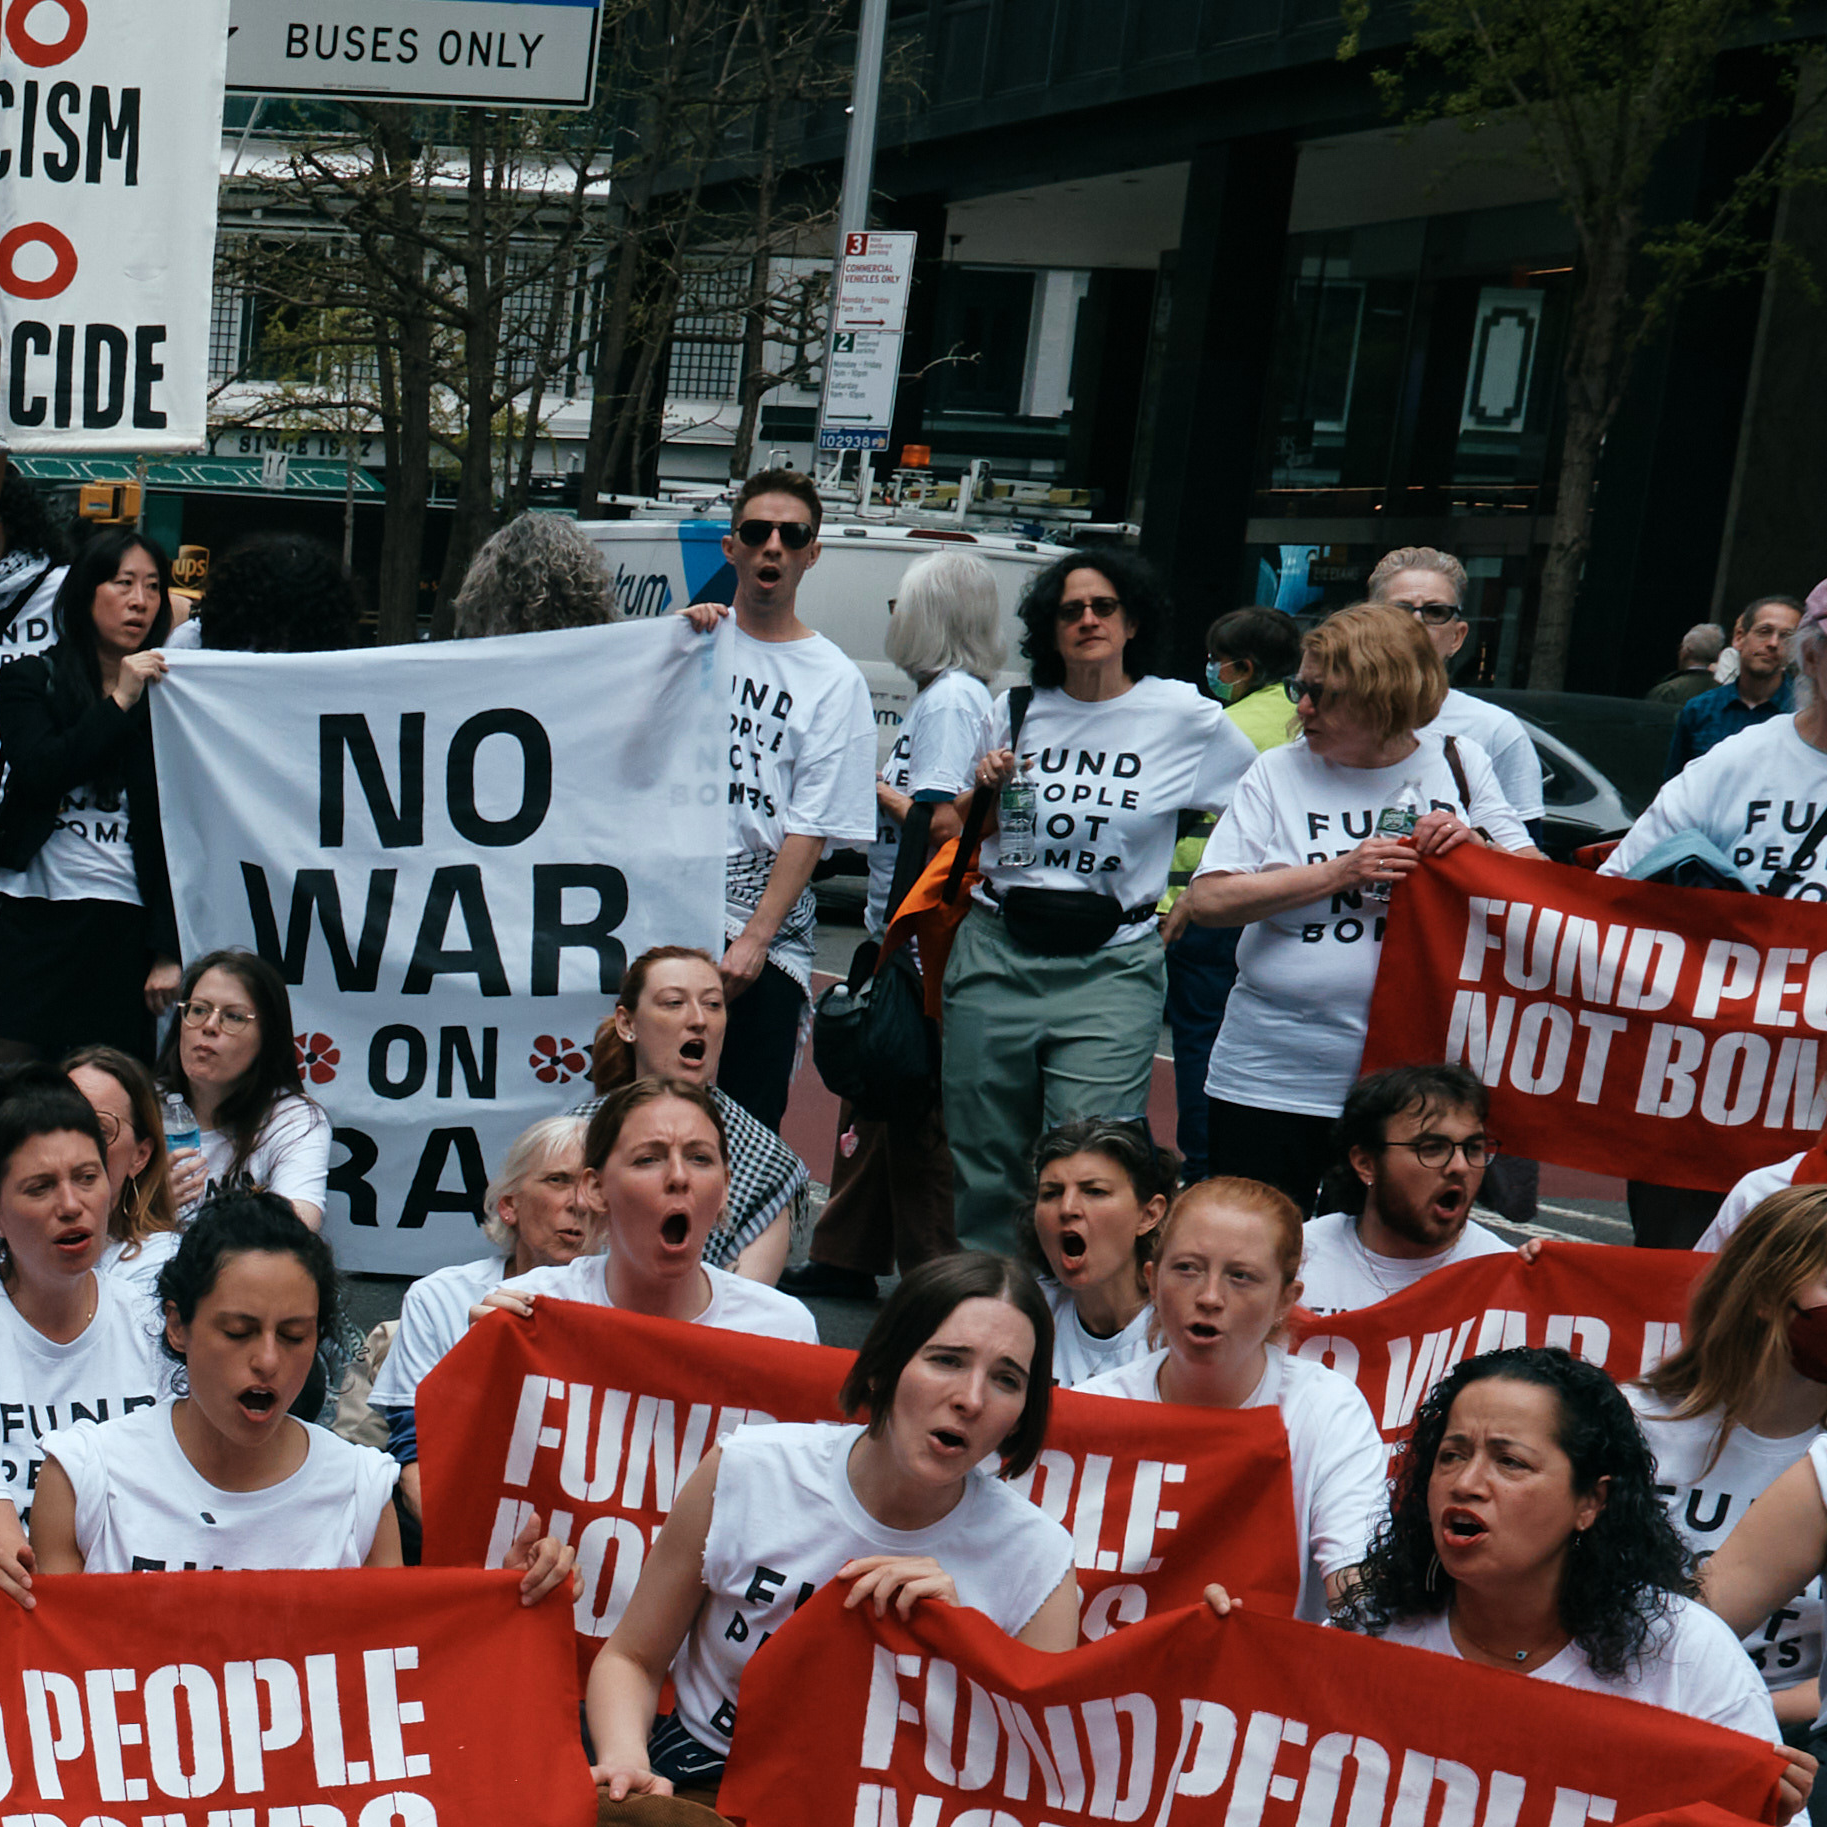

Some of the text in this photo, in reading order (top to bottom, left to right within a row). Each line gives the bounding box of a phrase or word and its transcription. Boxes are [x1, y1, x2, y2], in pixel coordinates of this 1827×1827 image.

[286, 22, 544, 69] BUSES ONLY
[850, 235, 863, 254] 3
[845, 275, 901, 284] VEHICLES ONLY
[846, 264, 894, 273] COMMERCIAL
[837, 333, 850, 351] 2
[821, 435, 871, 449] 102938
[174, 558, 207, 583] ups
[319, 707, 553, 848] NO
[1033, 783, 1140, 811] OPLE
[1031, 813, 1110, 843] OT
[240, 861, 629, 998] WAR
[1458, 895, 1687, 1013] FUND
[367, 1024, 498, 1101] ON
[1445, 989, 1628, 1106] NOT
[20, 1644, 432, 1802] PEOPLE
[858, 1643, 1161, 1824] FUND
